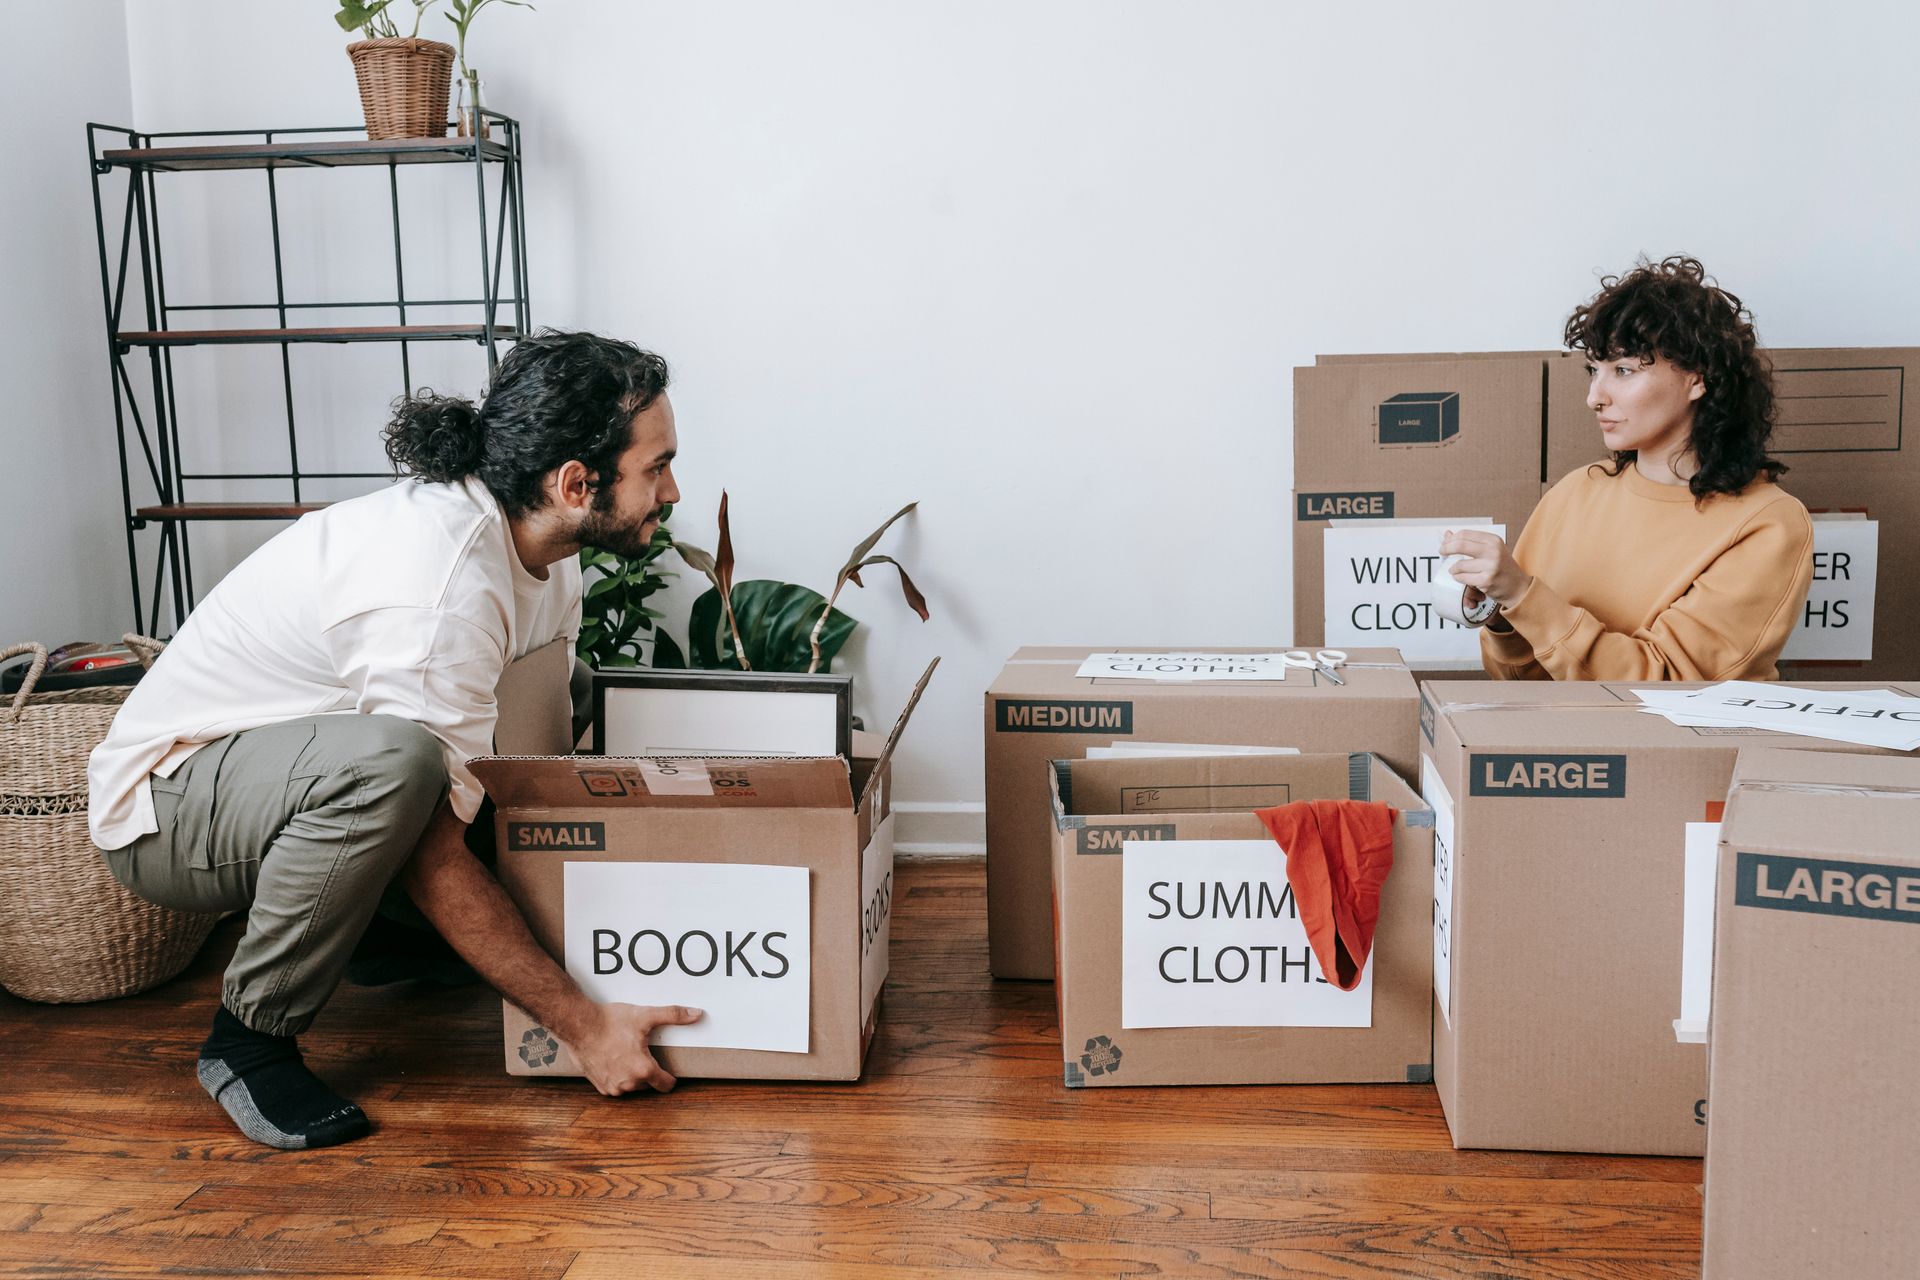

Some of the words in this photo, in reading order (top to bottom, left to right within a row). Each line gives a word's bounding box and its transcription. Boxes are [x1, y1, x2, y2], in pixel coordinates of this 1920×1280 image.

[1306, 496, 1385, 516] LARGE
[1350, 556, 1440, 584] WINT
[1351, 603, 1471, 630] CLOT
[1109, 664, 1258, 673] CLOTHS
[1006, 705, 1123, 728] MEDIUM
[1484, 761, 1610, 790] LARGE
[1135, 789, 1161, 806] ETC
[517, 826, 597, 847] SMALL
[1436, 833, 1449, 892] TER
[1147, 881, 1297, 920] SUMM
[1755, 863, 1920, 913] LARGE
[865, 871, 891, 957] BOOKS
[1434, 898, 1448, 959] THS
[592, 928, 790, 979] BOOKS
[1158, 945, 1329, 984] CLOTH
